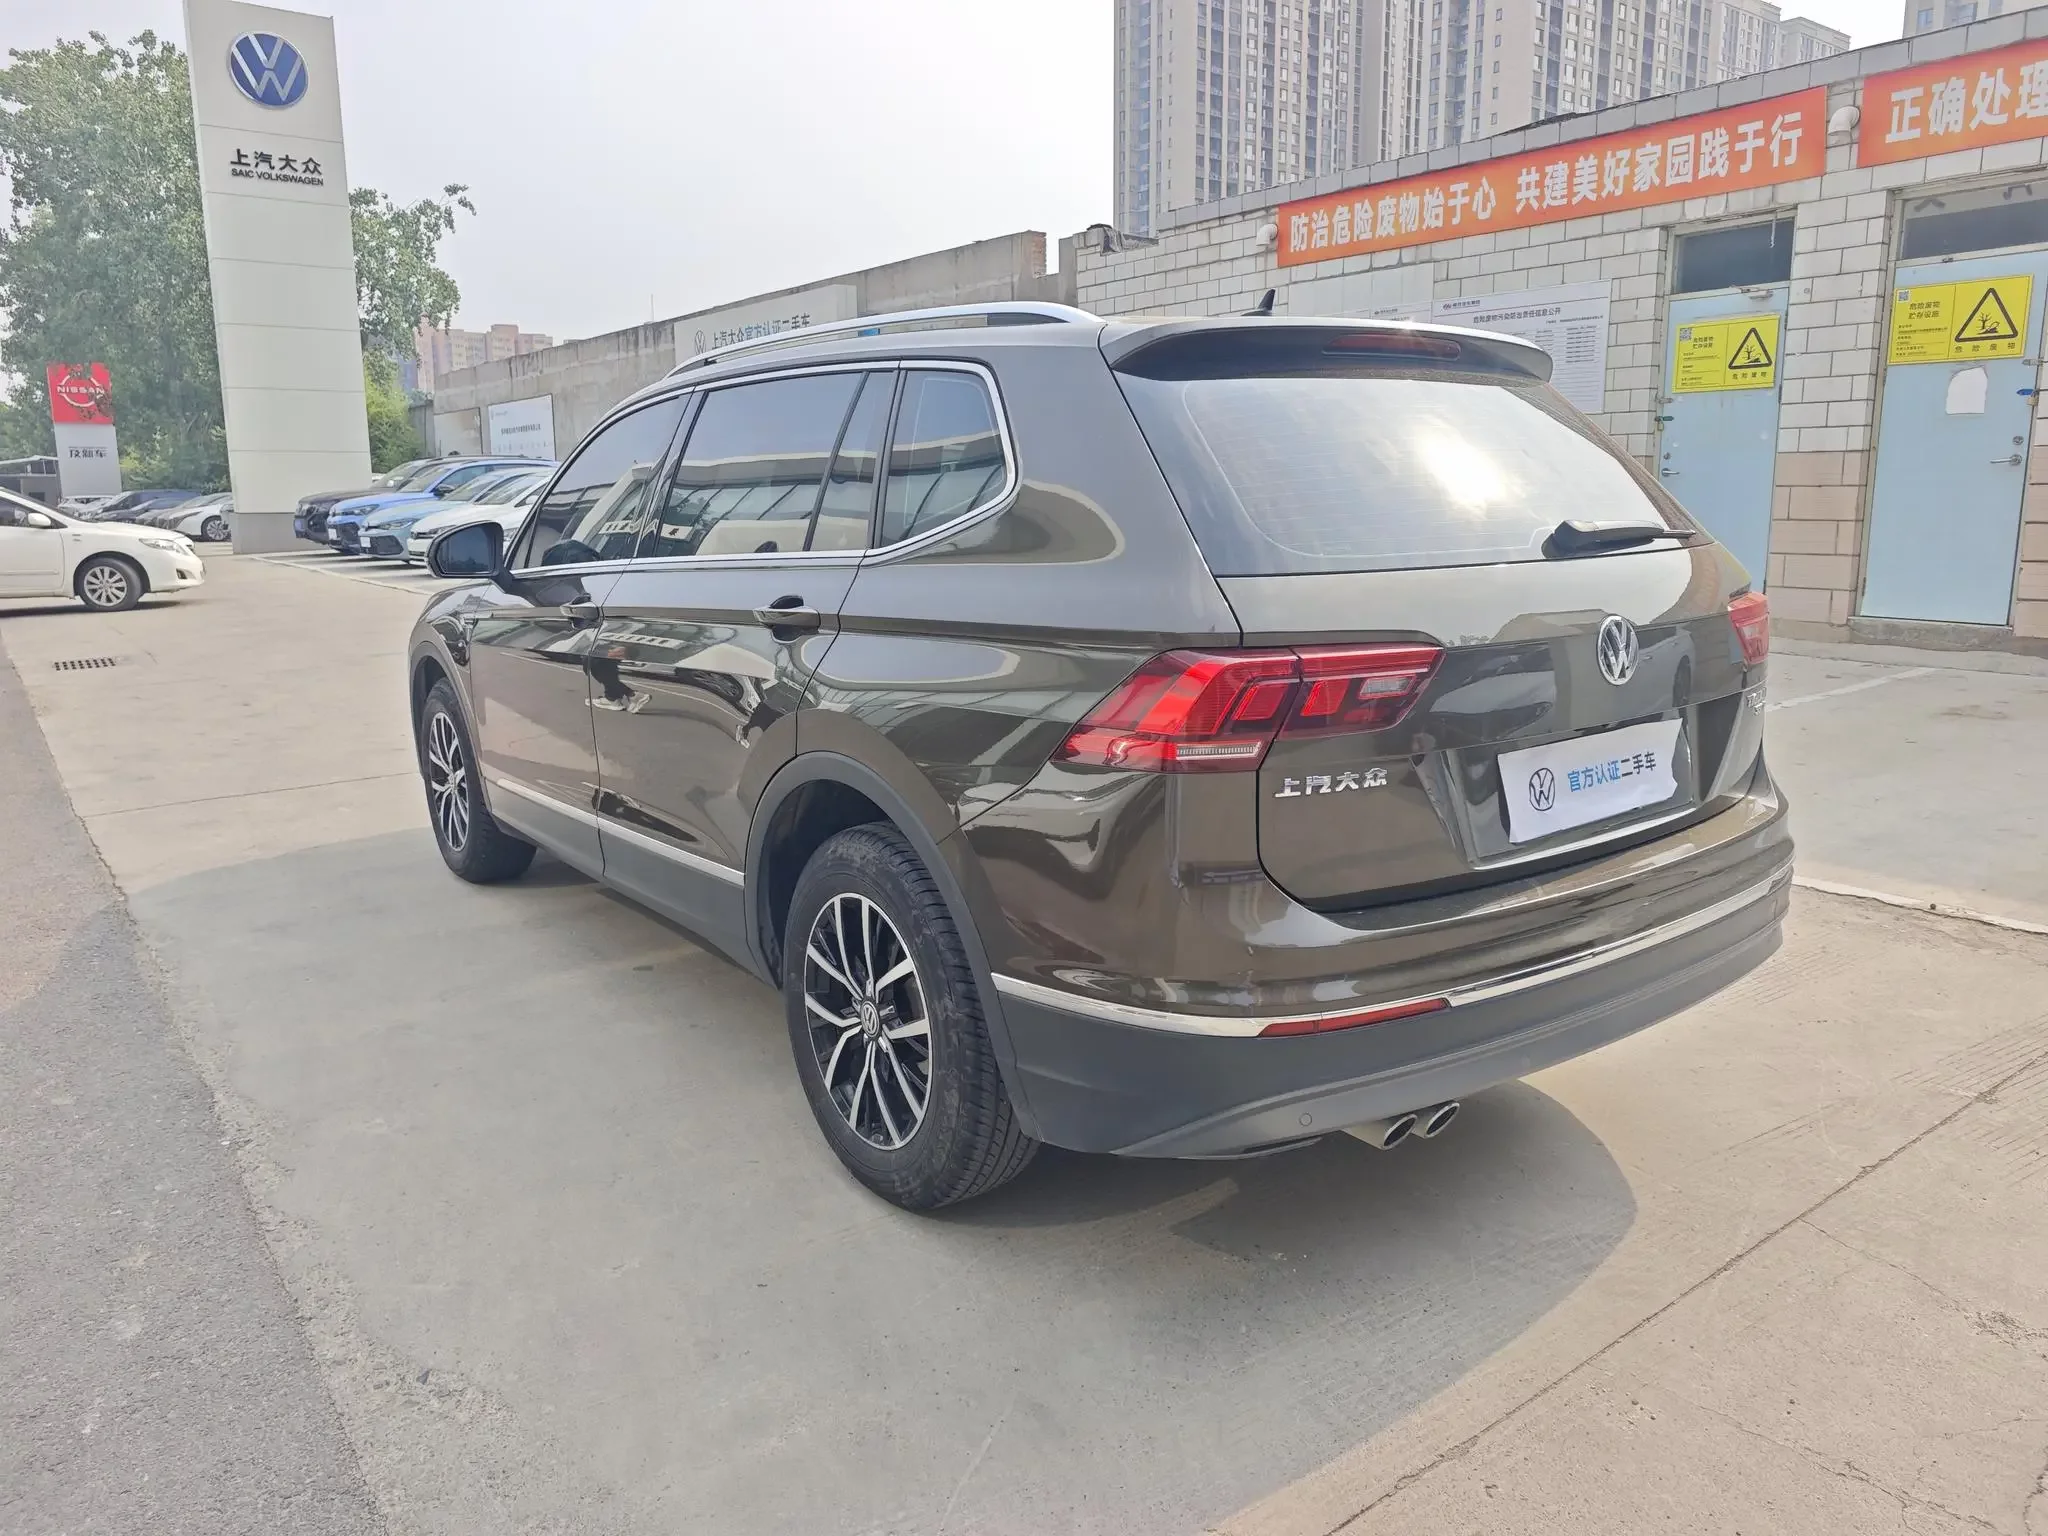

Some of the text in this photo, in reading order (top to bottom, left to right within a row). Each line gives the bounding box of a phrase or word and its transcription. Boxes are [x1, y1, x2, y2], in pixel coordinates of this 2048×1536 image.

[1885, 60, 2048, 144] 正确处理
[230, 148, 322, 176] 上汽大众
[231, 167, 324, 187] SAIC VOLKSWAGEN
[1290, 112, 1803, 253] 防治危险废物始于心 共建美好家园践于行
[712, 312, 810, 350] 上汽大众官方认证二手车
[57, 386, 105, 394] NISSAN
[1274, 767, 1388, 798] 上汽大众
[1567, 751, 1656, 792] 官方认证二手车
